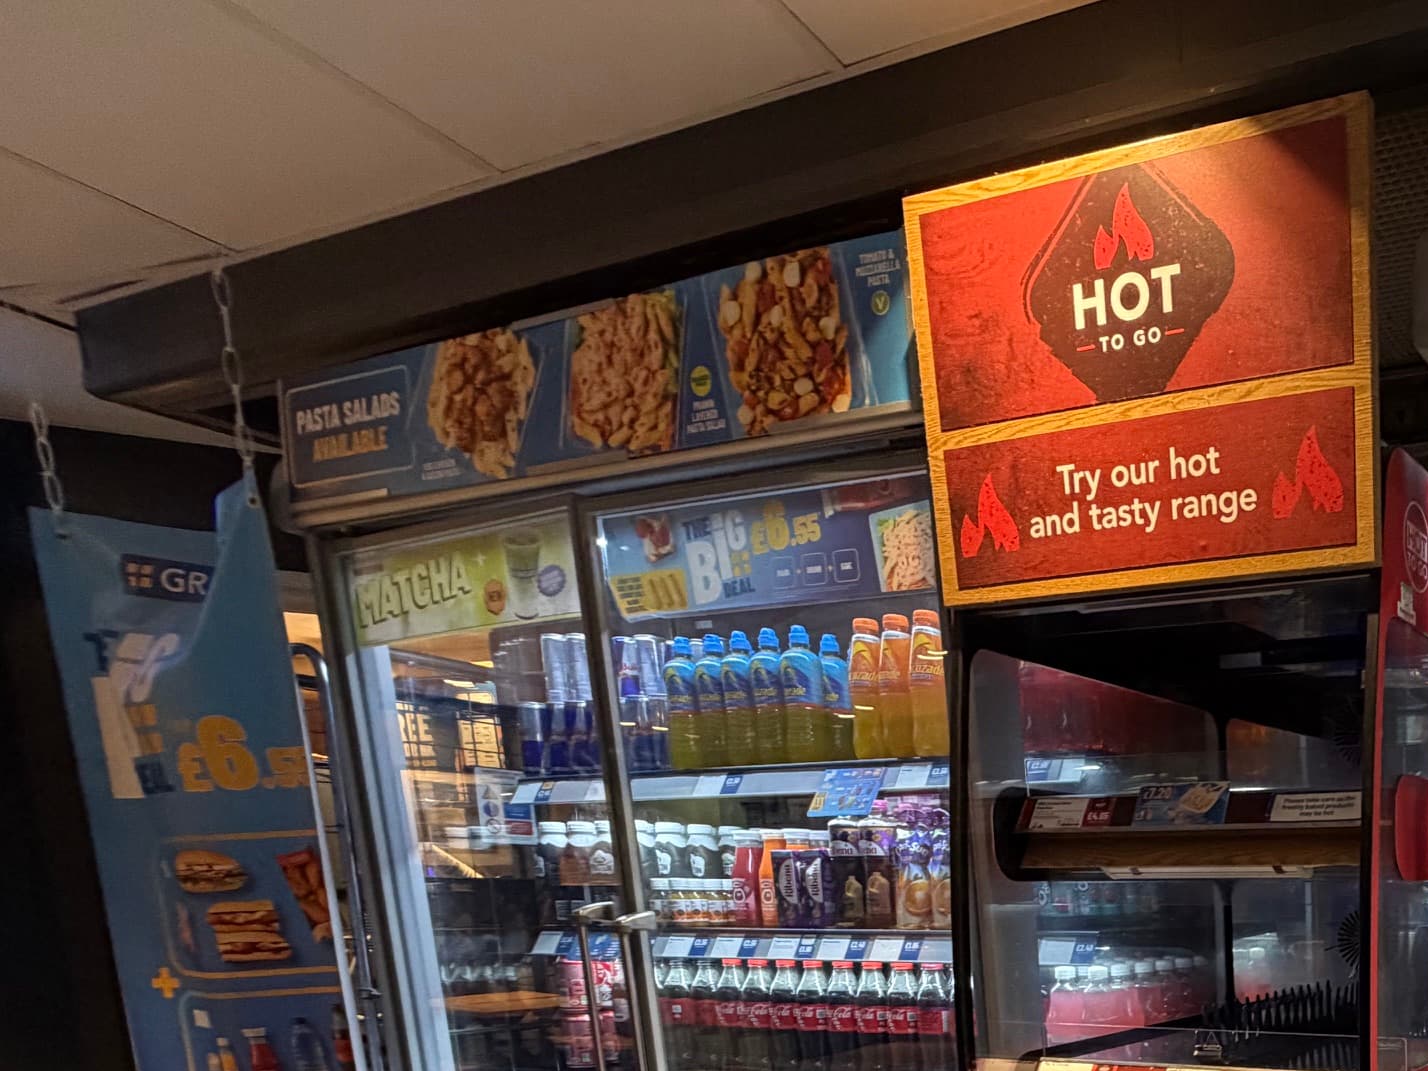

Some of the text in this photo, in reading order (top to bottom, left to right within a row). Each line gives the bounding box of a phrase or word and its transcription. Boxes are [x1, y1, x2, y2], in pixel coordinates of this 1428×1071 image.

[1072, 263, 1182, 331] HOT
[1099, 326, 1162, 353] TO GO
[296, 391, 400, 435] PASTA SALADS
[1056, 445, 1221, 502] Try our hot
[682, 518, 711, 540] THE
[1029, 484, 1259, 539] and tasty range
[685, 509, 747, 604] BIG
[355, 551, 472, 629] MATCHA
[723, 578, 755, 598] DEAL
